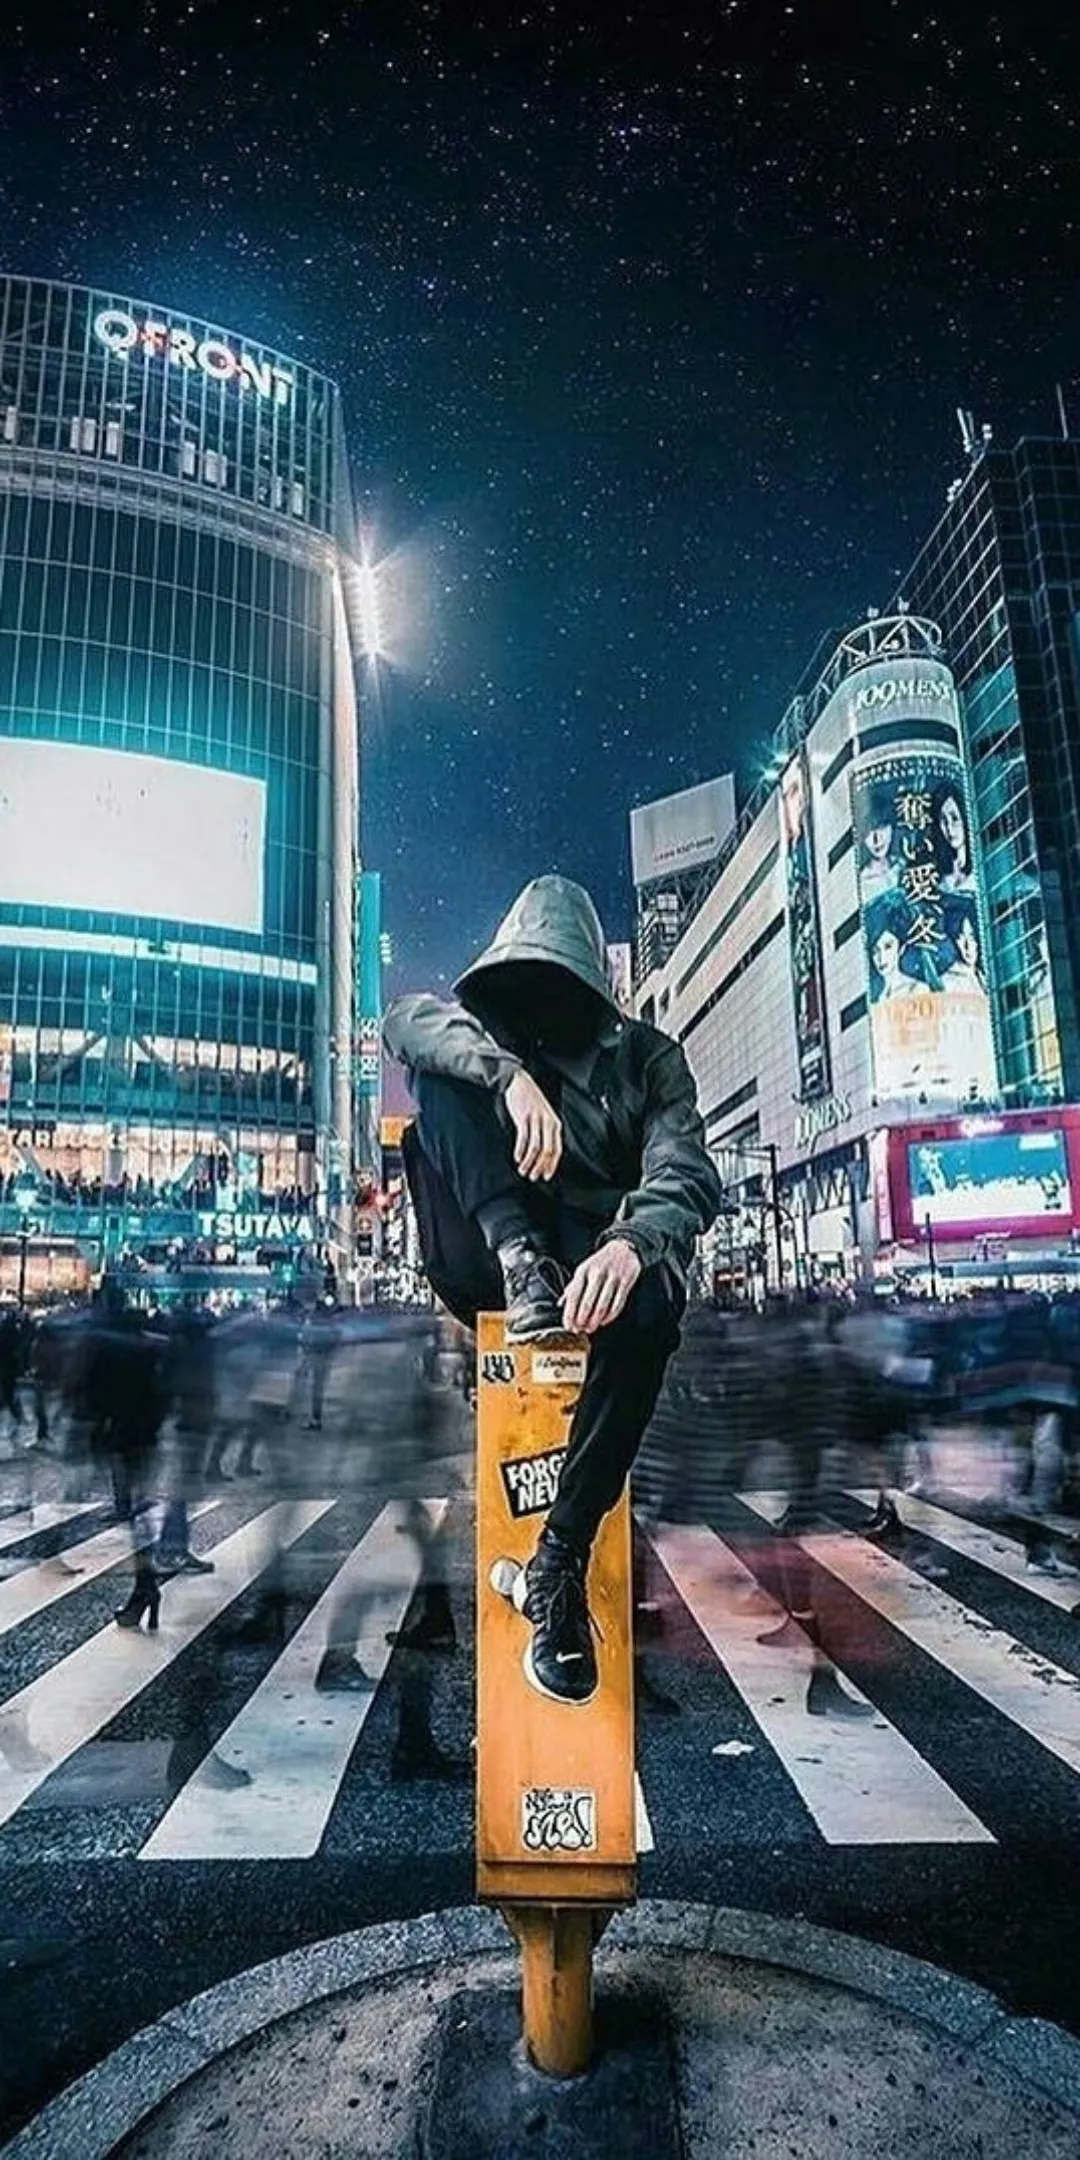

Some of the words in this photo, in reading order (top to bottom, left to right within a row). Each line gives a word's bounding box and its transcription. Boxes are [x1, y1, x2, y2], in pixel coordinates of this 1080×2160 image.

[94, 310, 294, 406] QFRONT
[199, 1212, 313, 1240] TSUTAYA
[505, 1452, 567, 1490] FORG
